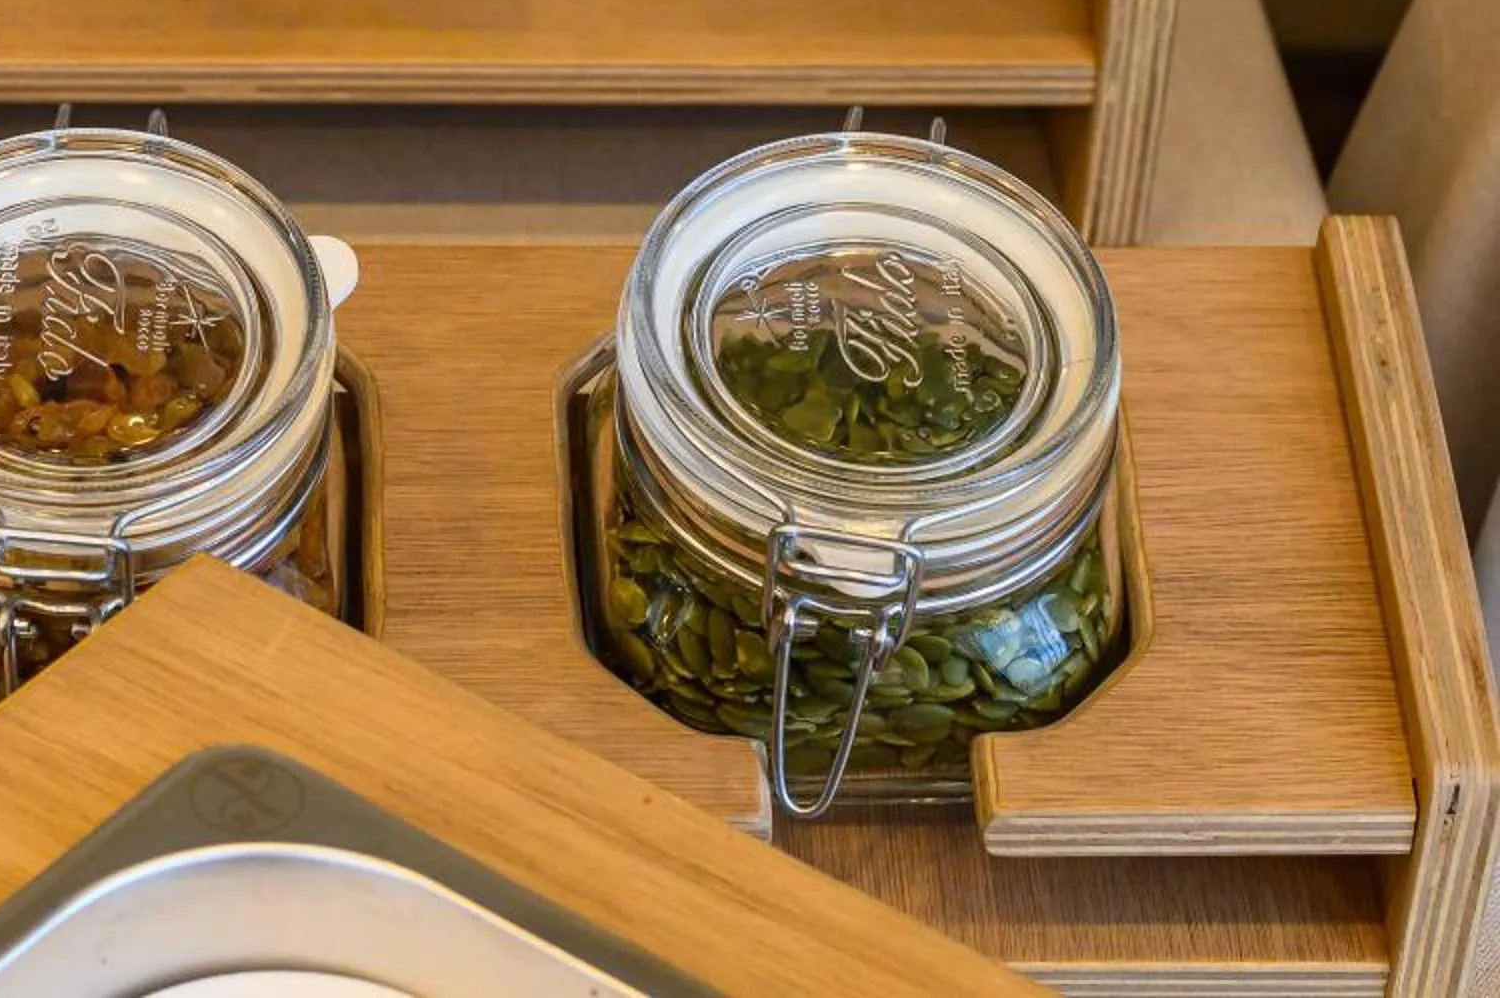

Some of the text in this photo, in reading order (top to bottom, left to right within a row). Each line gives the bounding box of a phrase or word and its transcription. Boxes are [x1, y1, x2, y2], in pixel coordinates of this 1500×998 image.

[37, 241, 126, 383] Fido
[831, 251, 923, 388] Fido
[947, 306, 965, 325] in
[943, 333, 974, 402] made
